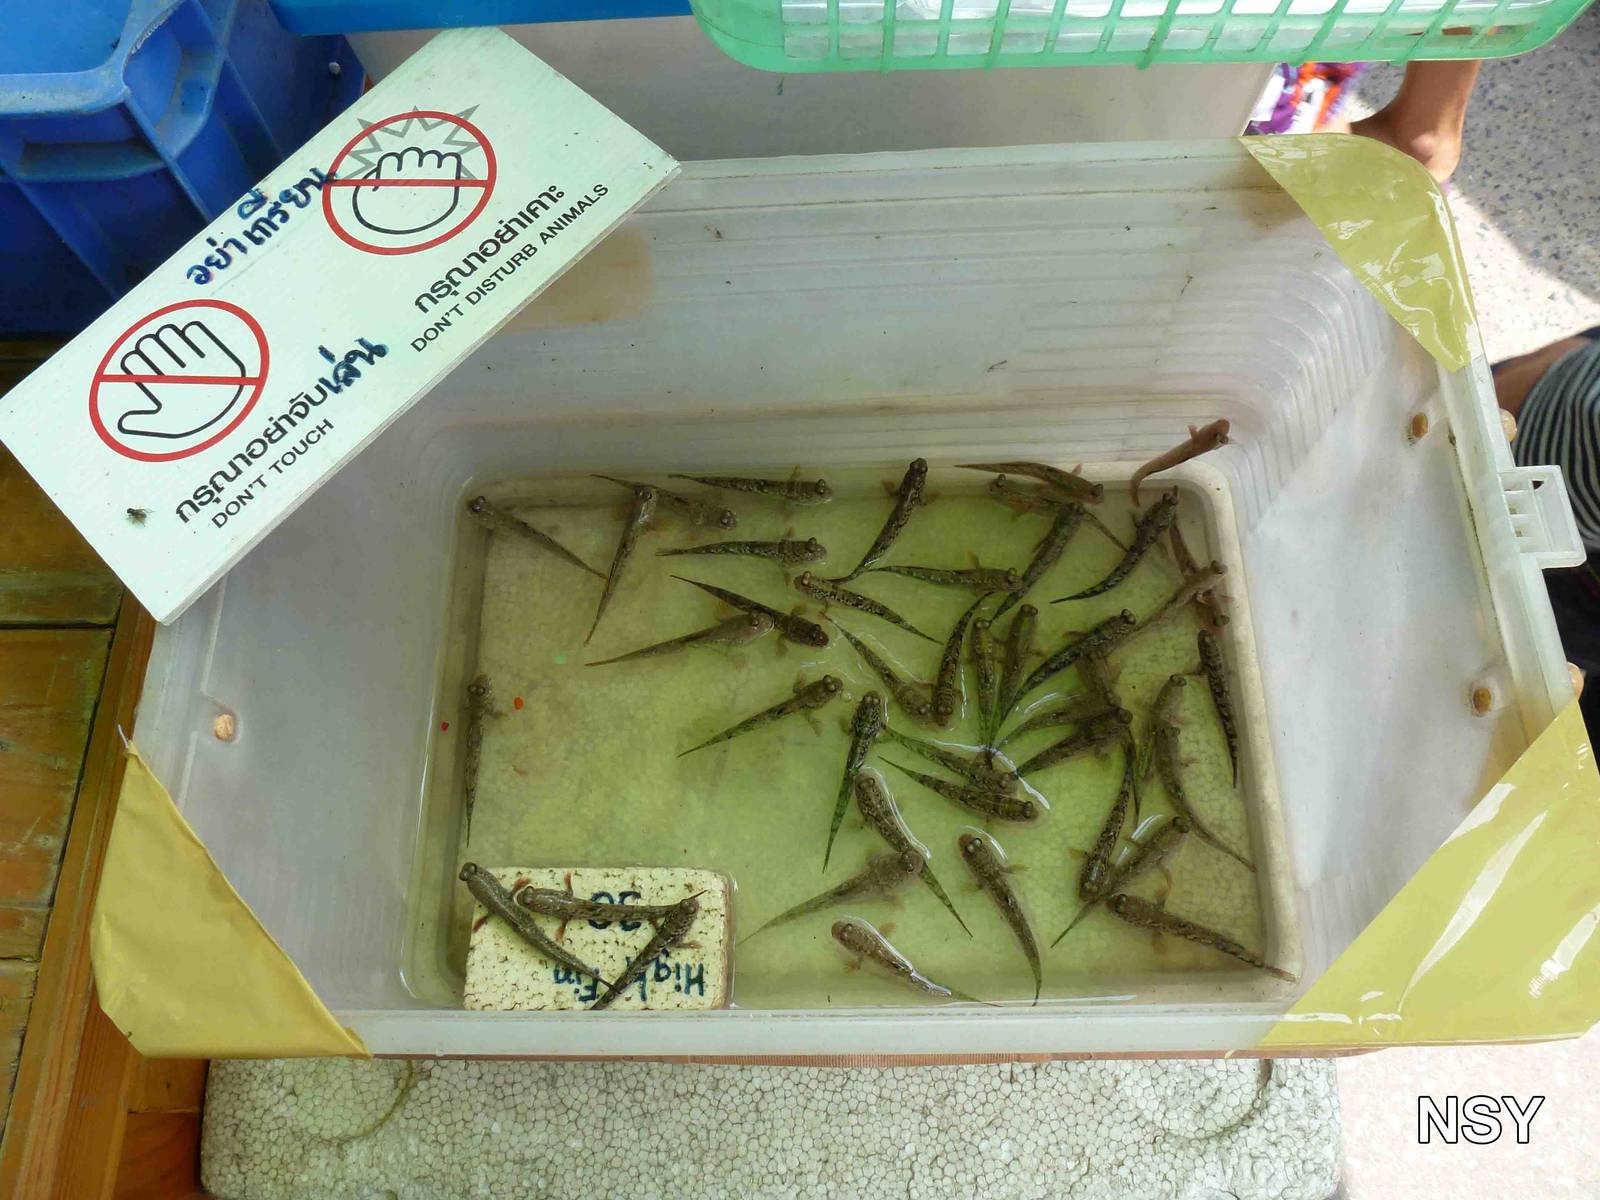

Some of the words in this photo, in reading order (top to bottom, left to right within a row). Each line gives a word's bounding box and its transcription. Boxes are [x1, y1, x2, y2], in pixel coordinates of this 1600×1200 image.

[410, 303, 464, 352] DON'T
[465, 243, 538, 306] DISTURB
[539, 183, 609, 245] ANIMALS
[415, 185, 565, 313] กรุณาอย่าเคาะ
[211, 474, 268, 528] DON'T
[268, 418, 335, 474] TOUCH
